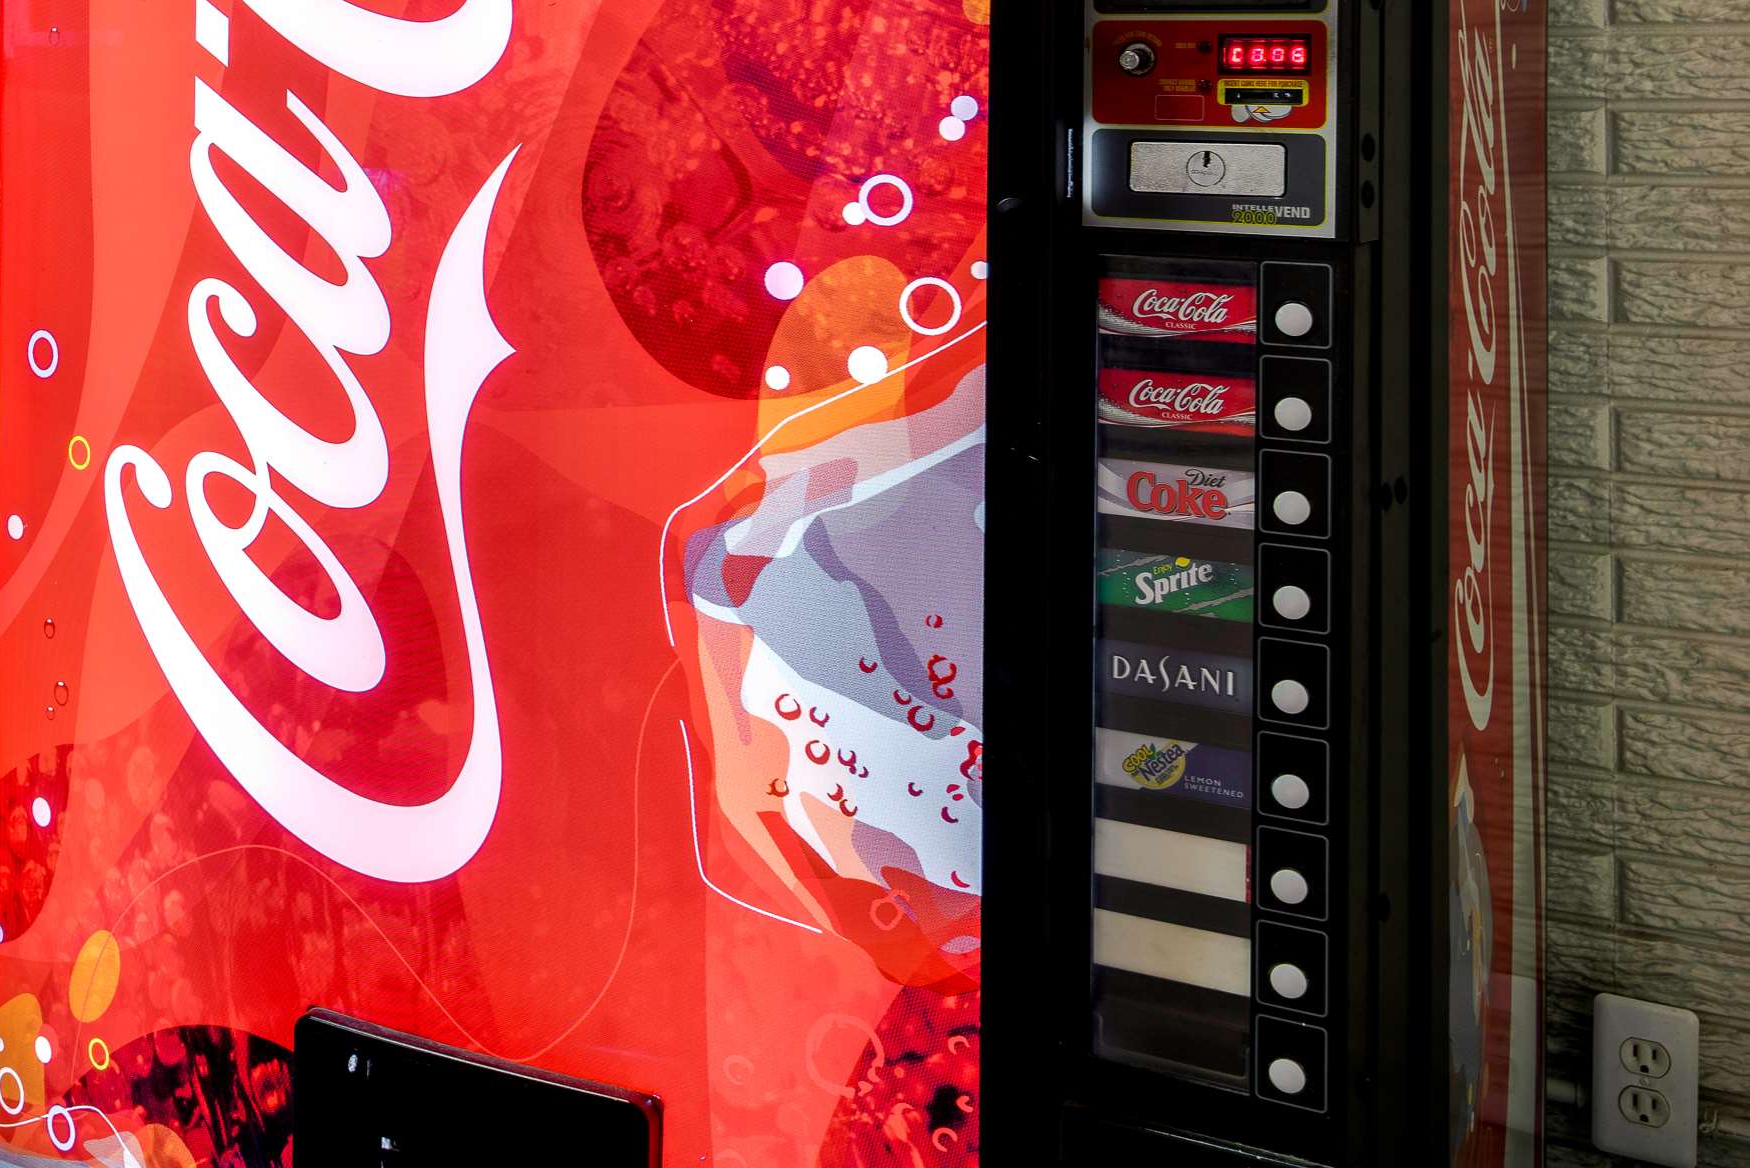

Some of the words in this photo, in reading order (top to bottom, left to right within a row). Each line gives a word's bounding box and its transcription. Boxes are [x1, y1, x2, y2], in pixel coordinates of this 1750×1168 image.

[1232, 211, 1277, 225] 2000
[1132, 288, 1235, 324] Coca-Cola
[1165, 321, 1198, 330] CLASSIC
[1128, 378, 1231, 415] Coca-Cola
[1161, 412, 1194, 421] CLASSIC
[1185, 468, 1227, 488] Diet
[1127, 470, 1228, 521] Coke
[1152, 563, 1173, 576] Enjoy
[1134, 562, 1214, 605] Sprite
[1112, 655, 1235, 696] DASANI
[1122, 743, 1154, 773] COOL
[1139, 743, 1186, 782] Nestea
[1184, 775, 1221, 787] LEMON
[1184, 782, 1244, 798] SWEETENED
